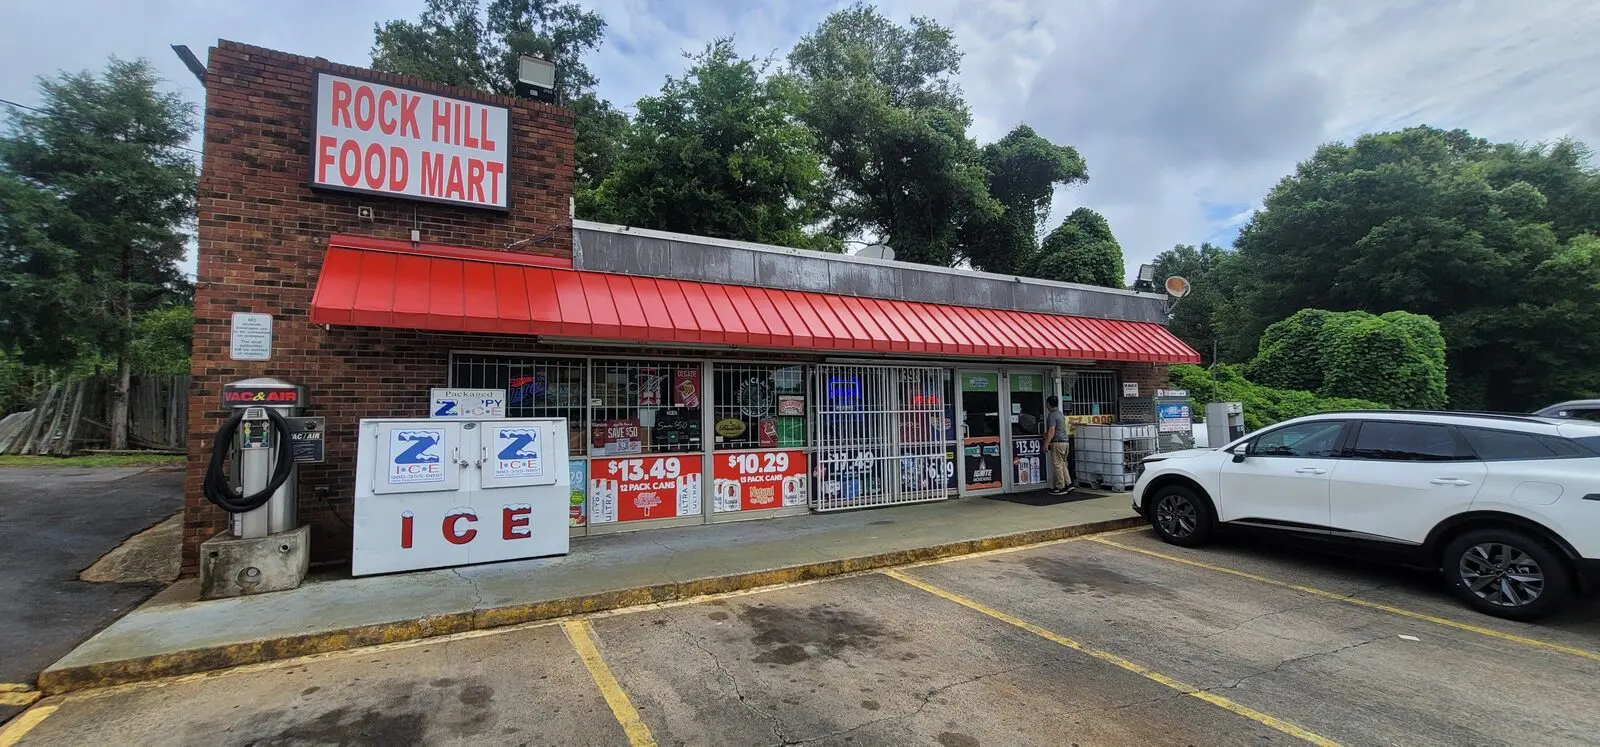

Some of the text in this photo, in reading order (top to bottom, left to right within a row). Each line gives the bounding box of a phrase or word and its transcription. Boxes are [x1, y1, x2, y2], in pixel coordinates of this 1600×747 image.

[331, 80, 495, 151] ROCK HILL
[318, 135, 504, 204] FOOD MART
[497, 428, 537, 460] Z
[607, 426, 638, 439] SAVE $50
[394, 431, 440, 464] Z
[1016, 440, 1041, 454] $13.99
[608, 457, 681, 481] $13.49
[729, 452, 789, 474] $10.29
[620, 481, 675, 492] 12 PACK CANS
[747, 475, 764, 483] PACK
[401, 503, 532, 549] ICE
